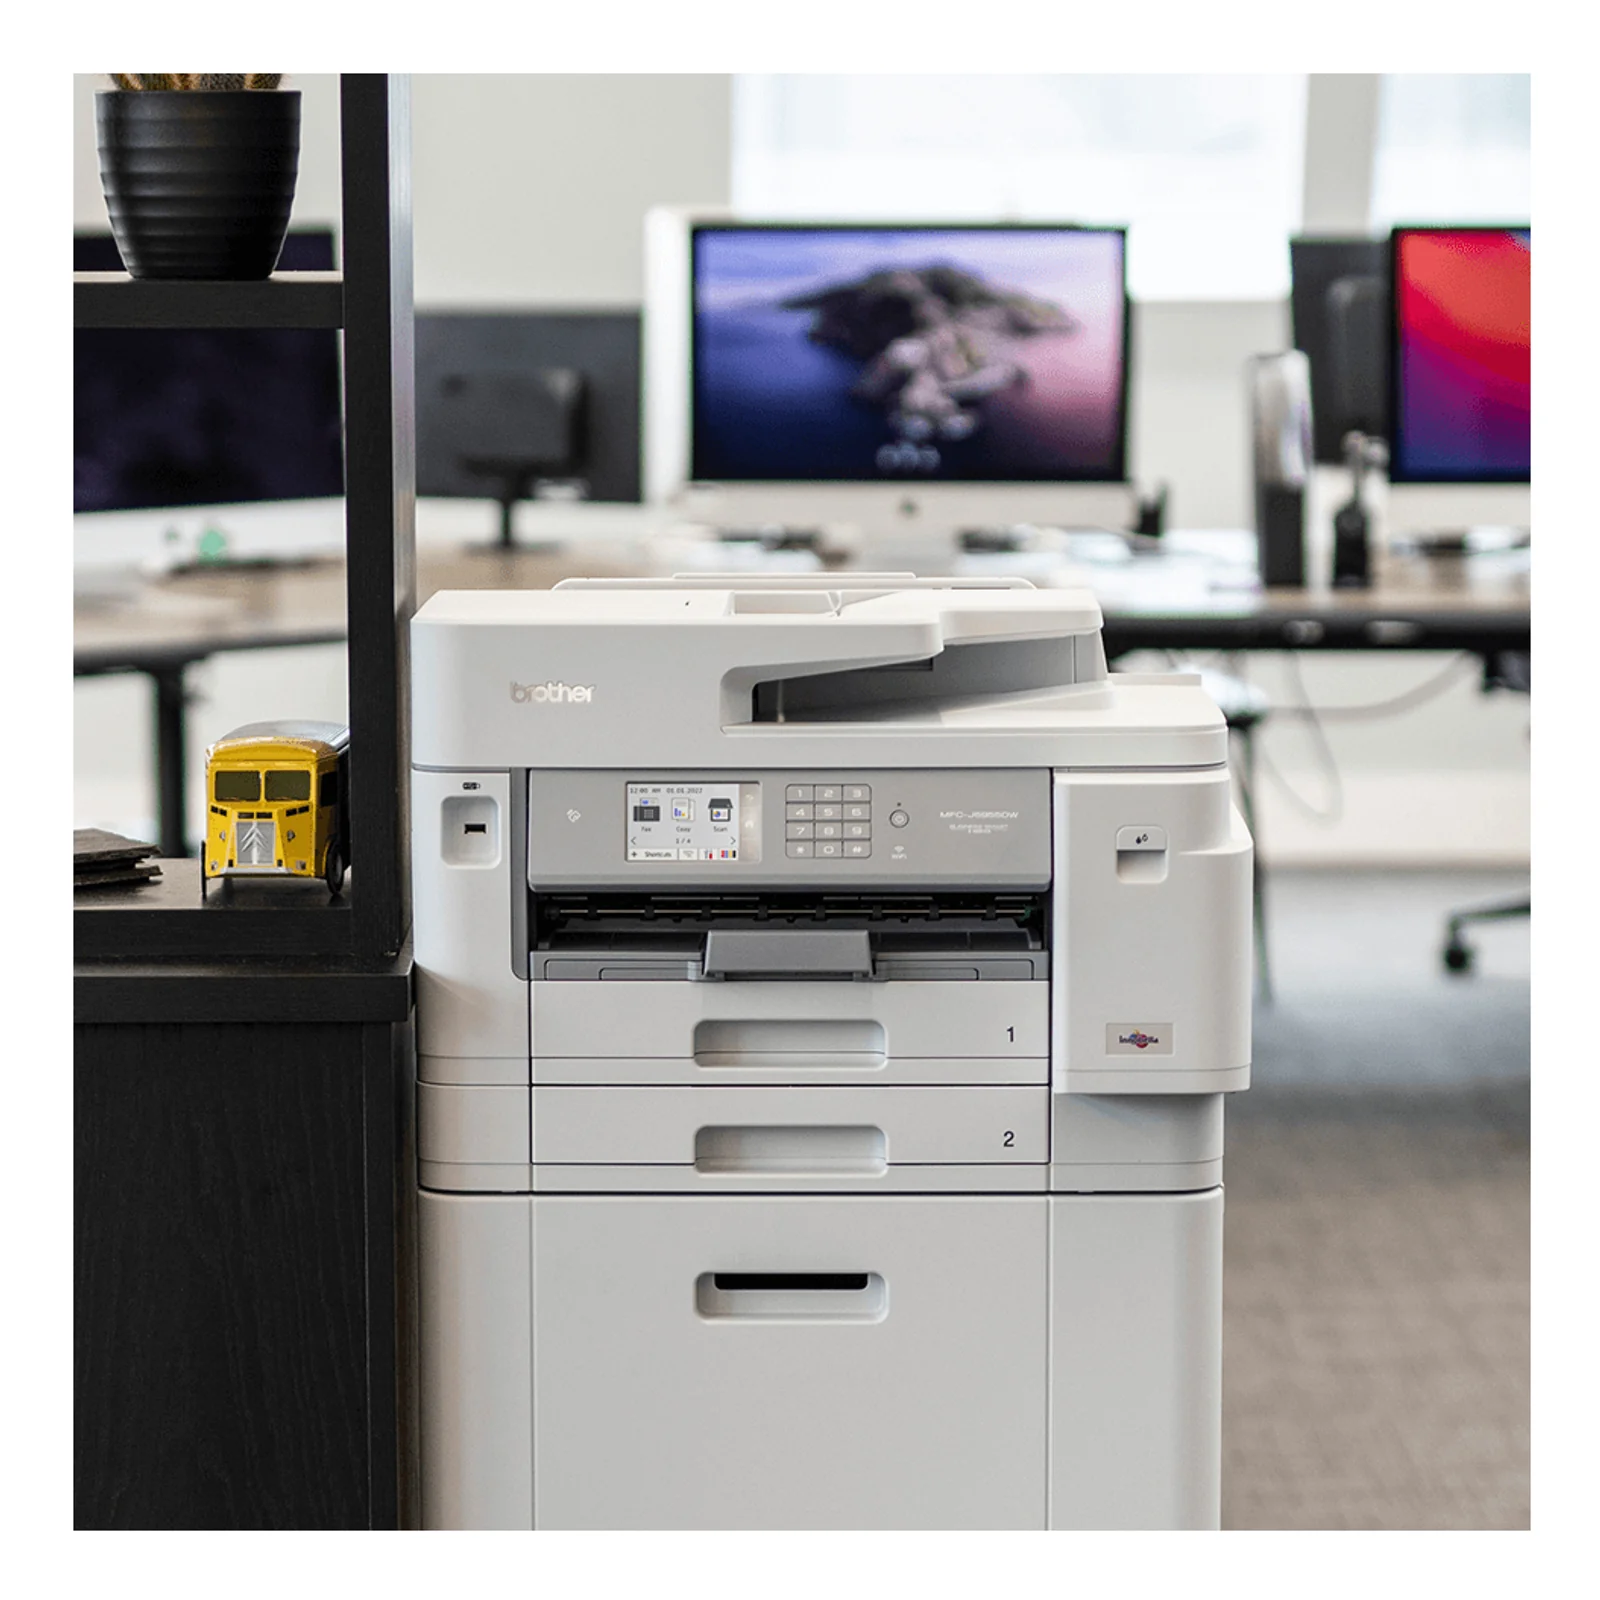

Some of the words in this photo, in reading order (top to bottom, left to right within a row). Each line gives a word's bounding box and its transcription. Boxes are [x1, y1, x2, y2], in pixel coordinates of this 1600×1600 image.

[509, 681, 596, 703] brother
[823, 789, 834, 798] 2
[852, 789, 862, 798] 3
[795, 807, 805, 817] 4
[823, 807, 833, 817] 5
[851, 807, 862, 817] 6
[796, 826, 806, 836] 7
[851, 826, 863, 836] 9
[1006, 1026, 1014, 1042] 1
[1003, 1130, 1015, 1147] 2
